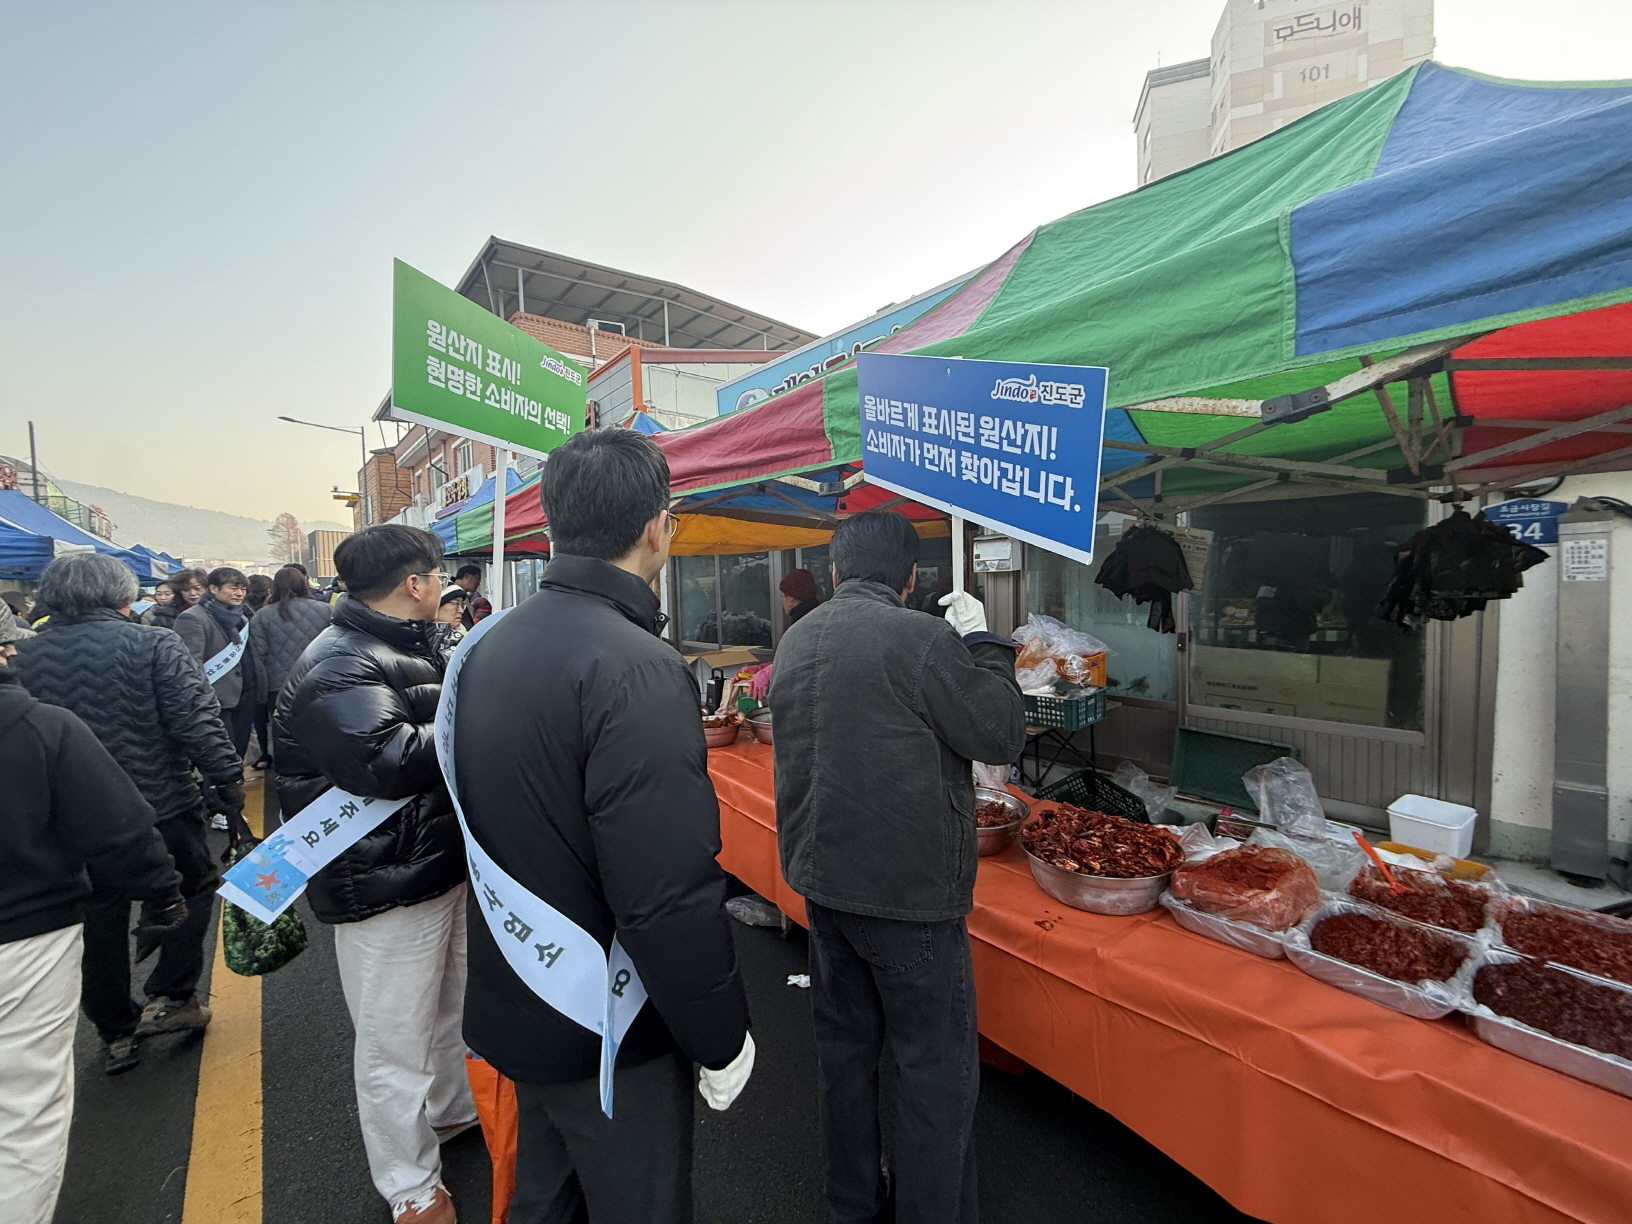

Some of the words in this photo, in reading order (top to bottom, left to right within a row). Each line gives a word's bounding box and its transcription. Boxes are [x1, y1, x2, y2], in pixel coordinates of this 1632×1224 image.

[1300, 63, 1330, 84] 101
[427, 319, 482, 369] 원산지
[486, 348, 521, 386] 표시!
[427, 355, 482, 402] 현명한
[485, 383, 541, 425] 소비자의
[544, 407, 571, 435] 선택!
[565, 368, 581, 385] 진도군
[992, 381, 1029, 400] Jindo
[1040, 383, 1083, 405] 진도군
[864, 395, 919, 432] 올바르게
[922, 406, 975, 444] 표시된
[979, 416, 1058, 461] 원산지!
[866, 428, 921, 467] 소비자가
[924, 441, 956, 478] 먼저
[960, 451, 1081, 513] 찾아갑니다.
[1506, 521, 1544, 540] 34
